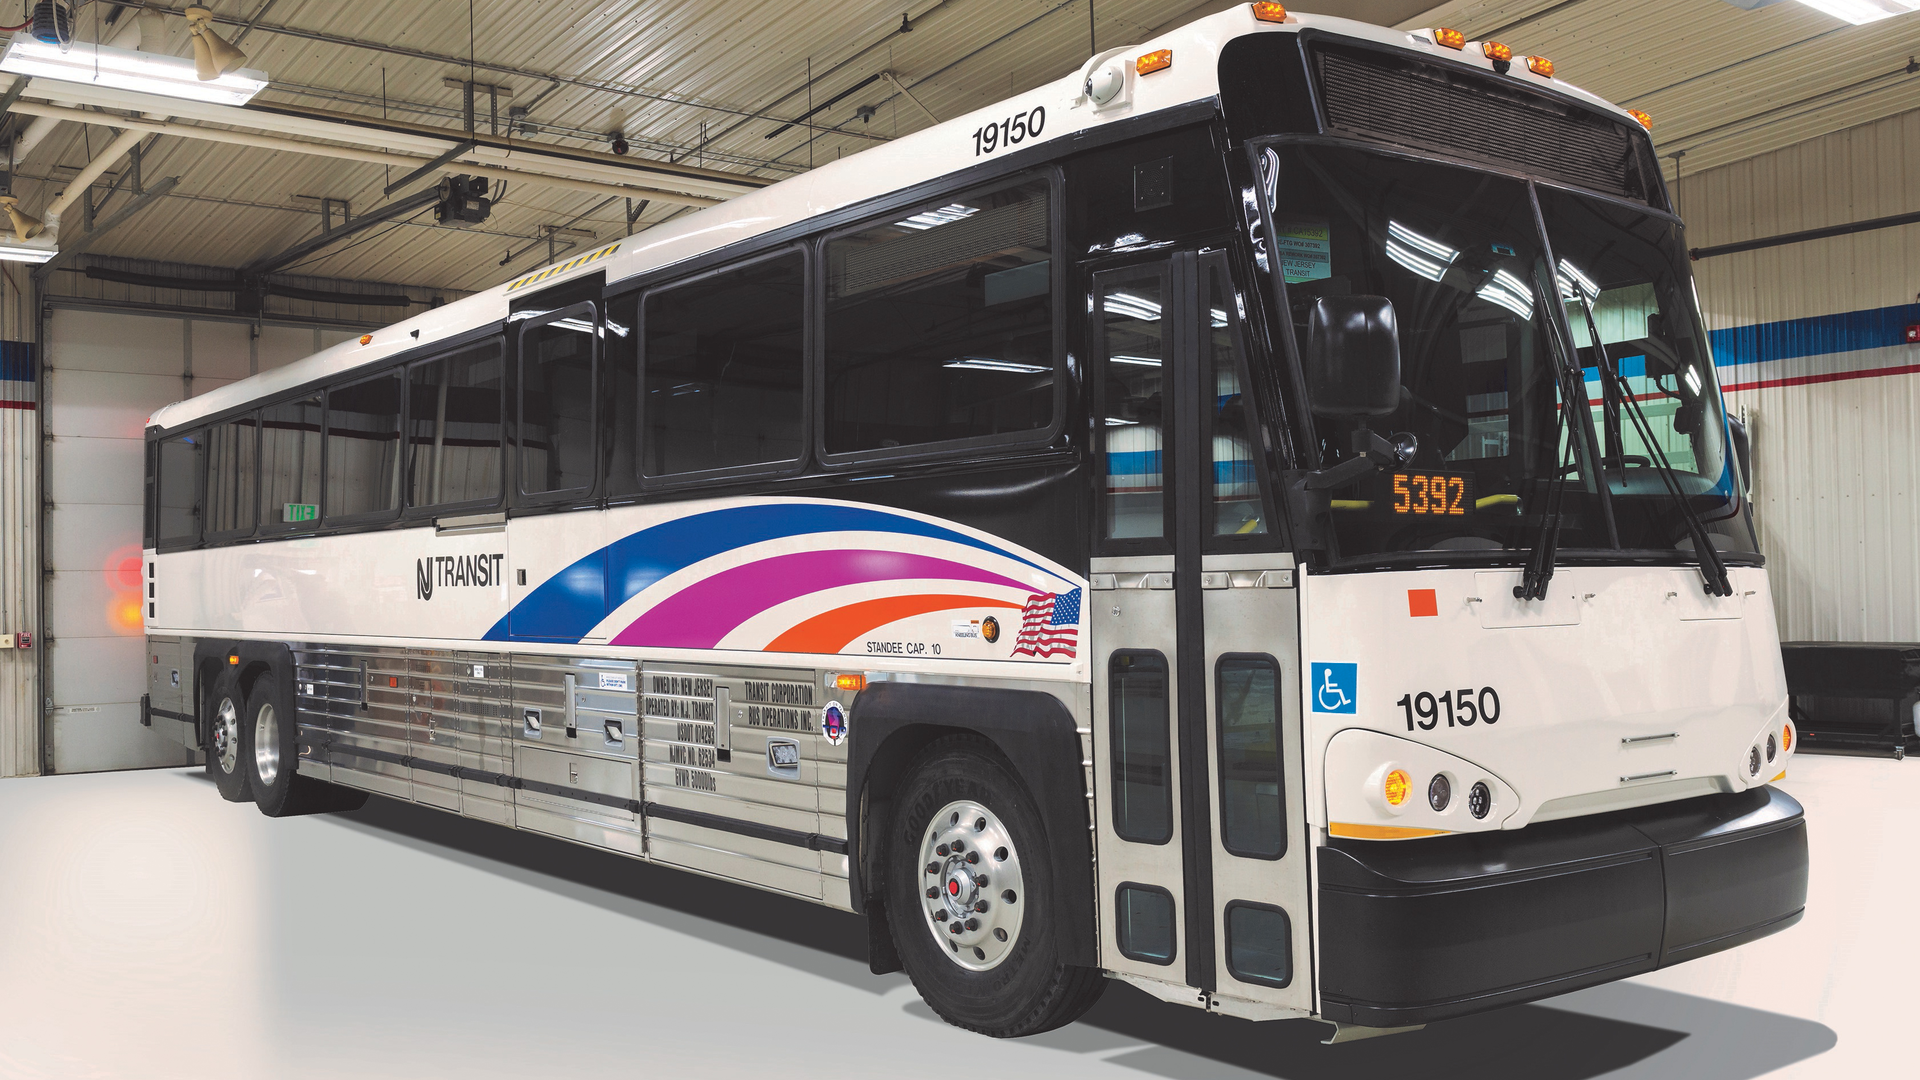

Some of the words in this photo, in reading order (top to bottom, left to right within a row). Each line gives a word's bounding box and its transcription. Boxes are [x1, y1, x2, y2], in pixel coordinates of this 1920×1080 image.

[972, 106, 1046, 156] 19150
[1286, 269, 1311, 277] TRANSIT
[1294, 260, 1316, 269] JERSEY
[1394, 474, 1464, 515] 5392
[435, 553, 504, 587] TRANSIT
[866, 641, 903, 654] STANDEE
[906, 643, 928, 655] CAP.
[931, 643, 941, 655] 10
[652, 675, 670, 694] OWNED
[671, 677, 680, 695] BY:
[680, 677, 692, 696] NEW
[693, 677, 714, 698] JERSEY
[744, 681, 769, 702] TRANSIT
[771, 682, 813, 706] CORPORATION
[645, 697, 670, 716] OPERATED
[671, 699, 680, 717] BY:
[680, 700, 691, 719] N.J.
[692, 701, 714, 721] TRANSIT
[748, 706, 760, 726] BUS
[761, 706, 798, 730] OPERATIONS
[800, 710, 814, 731] INC.
[1397, 686, 1501, 731] 19150
[676, 722, 694, 742] USDOT
[695, 724, 715, 745] 074293
[669, 744, 687, 764] NJMVC
[687, 746, 697, 765] NO.
[698, 747, 716, 769] 62534
[674, 767, 690, 787] GVWR
